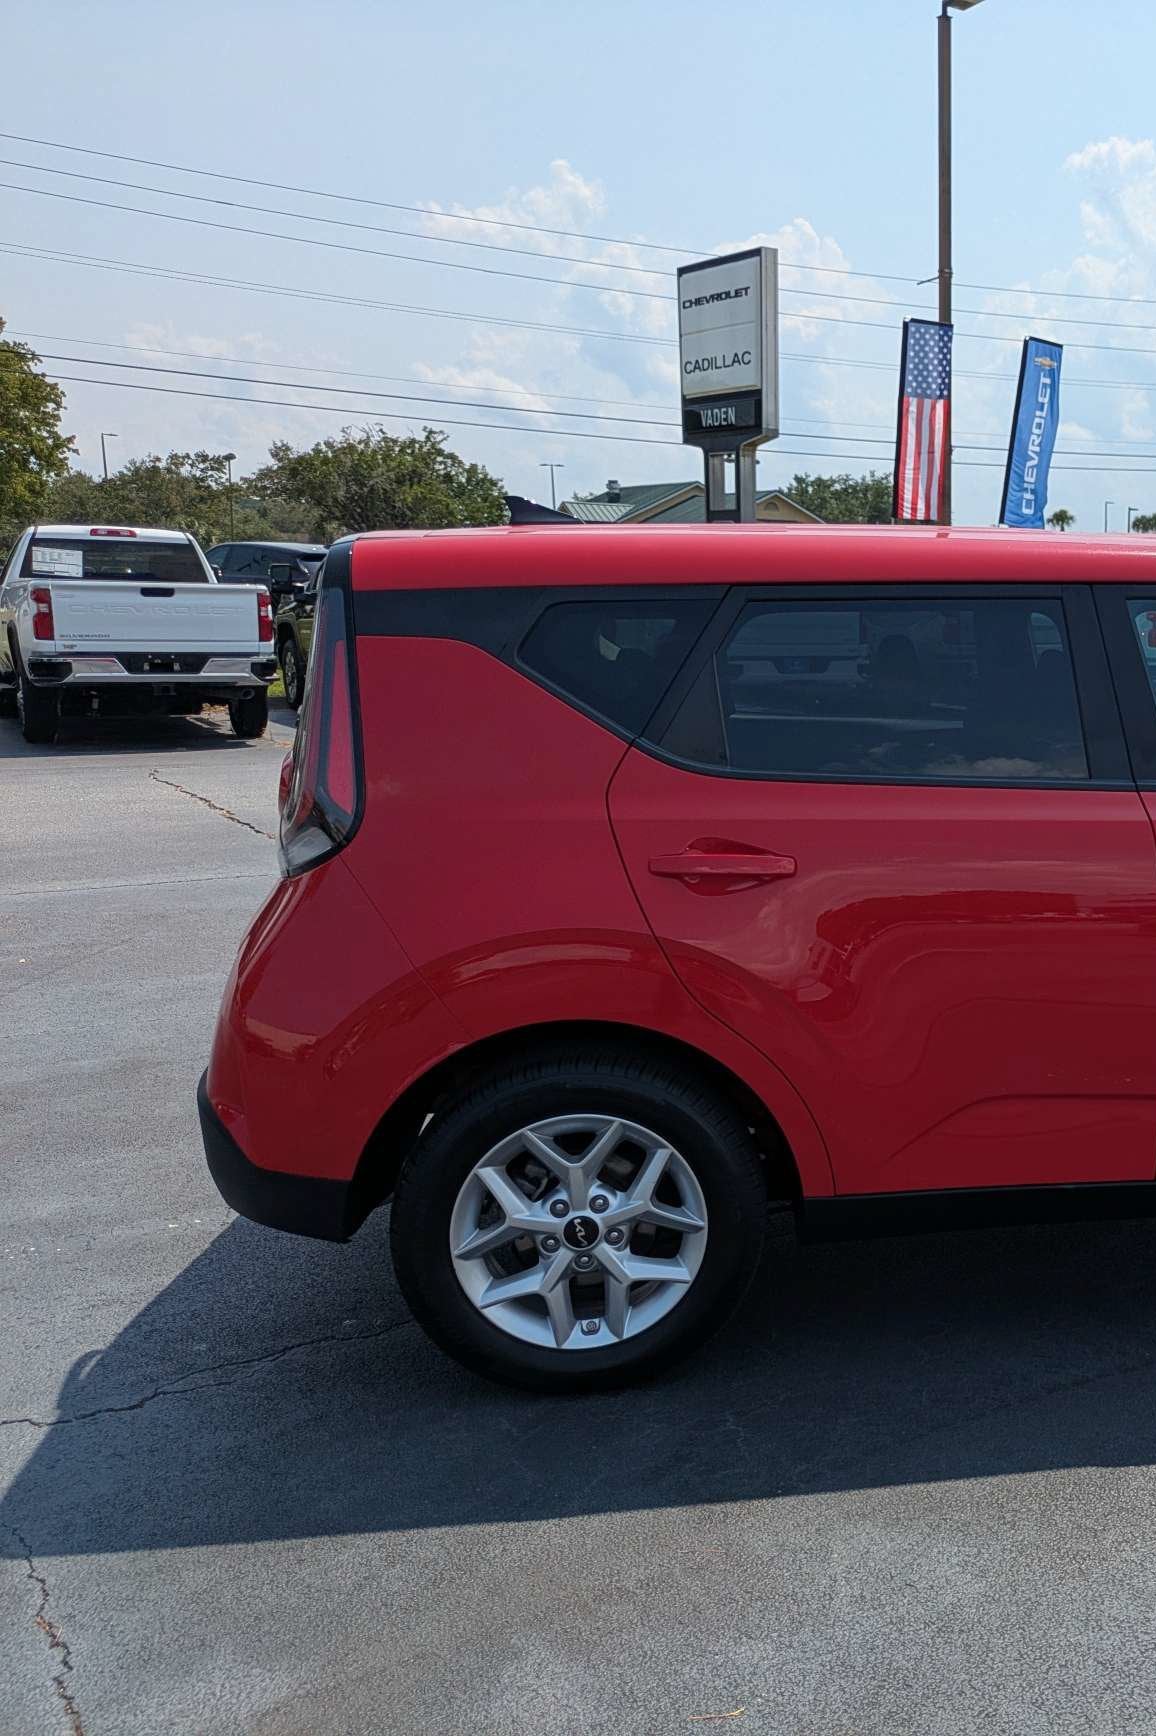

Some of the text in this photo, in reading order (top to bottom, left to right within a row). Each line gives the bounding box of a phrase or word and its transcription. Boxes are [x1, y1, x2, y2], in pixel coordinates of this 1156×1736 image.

[682, 286, 750, 310] CHEVROLET
[684, 350, 752, 375] CADILLAC
[700, 406, 736, 428] VADEN
[1021, 371, 1052, 515] CHEVROLET
[67, 603, 250, 616] CHEVROLET
